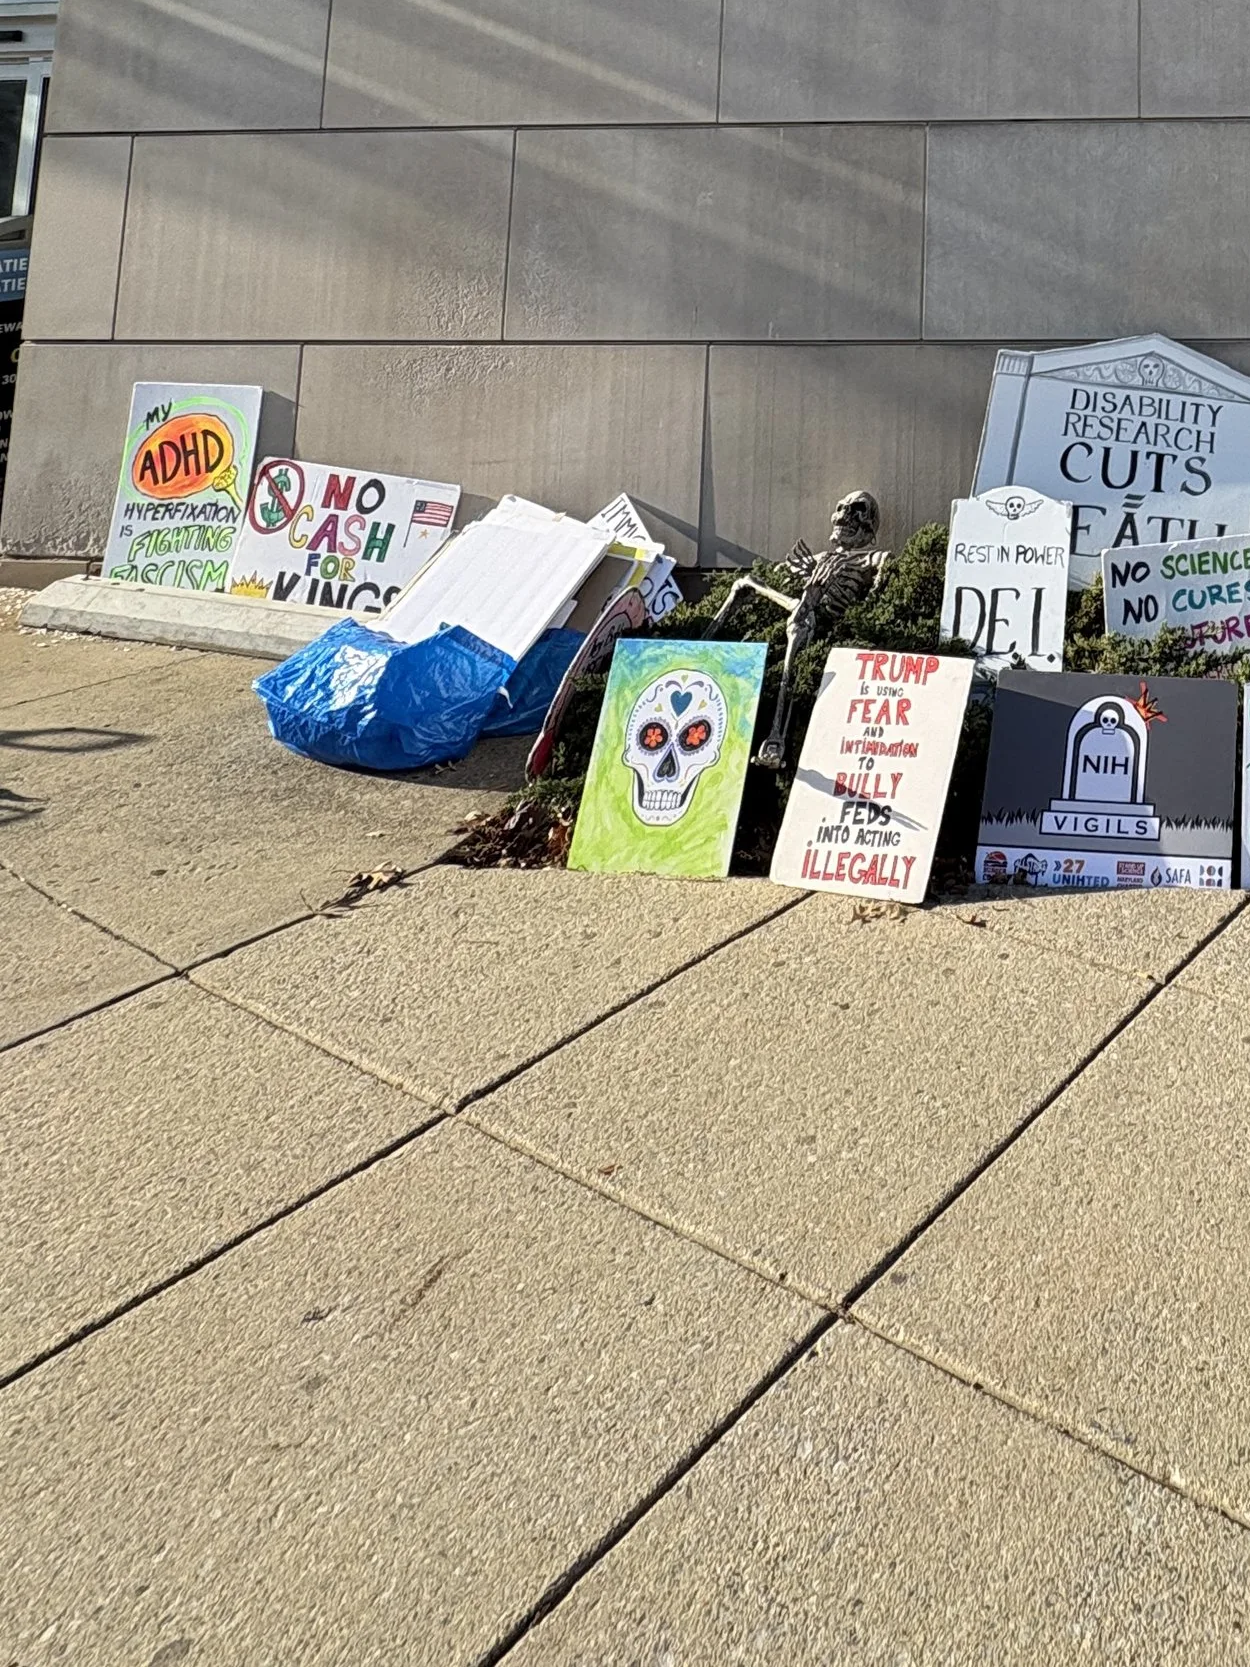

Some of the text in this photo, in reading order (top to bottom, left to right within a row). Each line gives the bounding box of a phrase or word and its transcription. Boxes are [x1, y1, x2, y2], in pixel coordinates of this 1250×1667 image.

[144, 398, 173, 429] MY
[1069, 388, 1224, 428] DISABILITY
[1061, 412, 1216, 454] RESEARCH
[139, 429, 225, 485] ADHD
[1060, 442, 1212, 496] CUTS
[321, 474, 386, 515] NO
[124, 501, 241, 523] HYPERFIXATION
[119, 525, 133, 538] IS
[128, 525, 236, 563] FIGHTING
[288, 504, 396, 563] CASH
[304, 552, 356, 582] FOR
[955, 543, 1065, 569] REST IN POWER
[1111, 560, 1150, 588] NO
[1122, 594, 1158, 626] NO
[855, 653, 939, 686] TRUMP
[877, 686, 904, 697] USING
[847, 699, 911, 725] FEAR
[863, 726, 884, 738] AND
[858, 757, 874, 770] TO
[1082, 754, 1129, 775] NIH
[833, 772, 903, 800] BULLY
[840, 801, 892, 826] FEDS
[1053, 815, 1149, 835] VIGILS
[854, 830, 901, 847] ACTING
[1062, 858, 1086, 874] 27
[1165, 867, 1191, 884] SAFA
